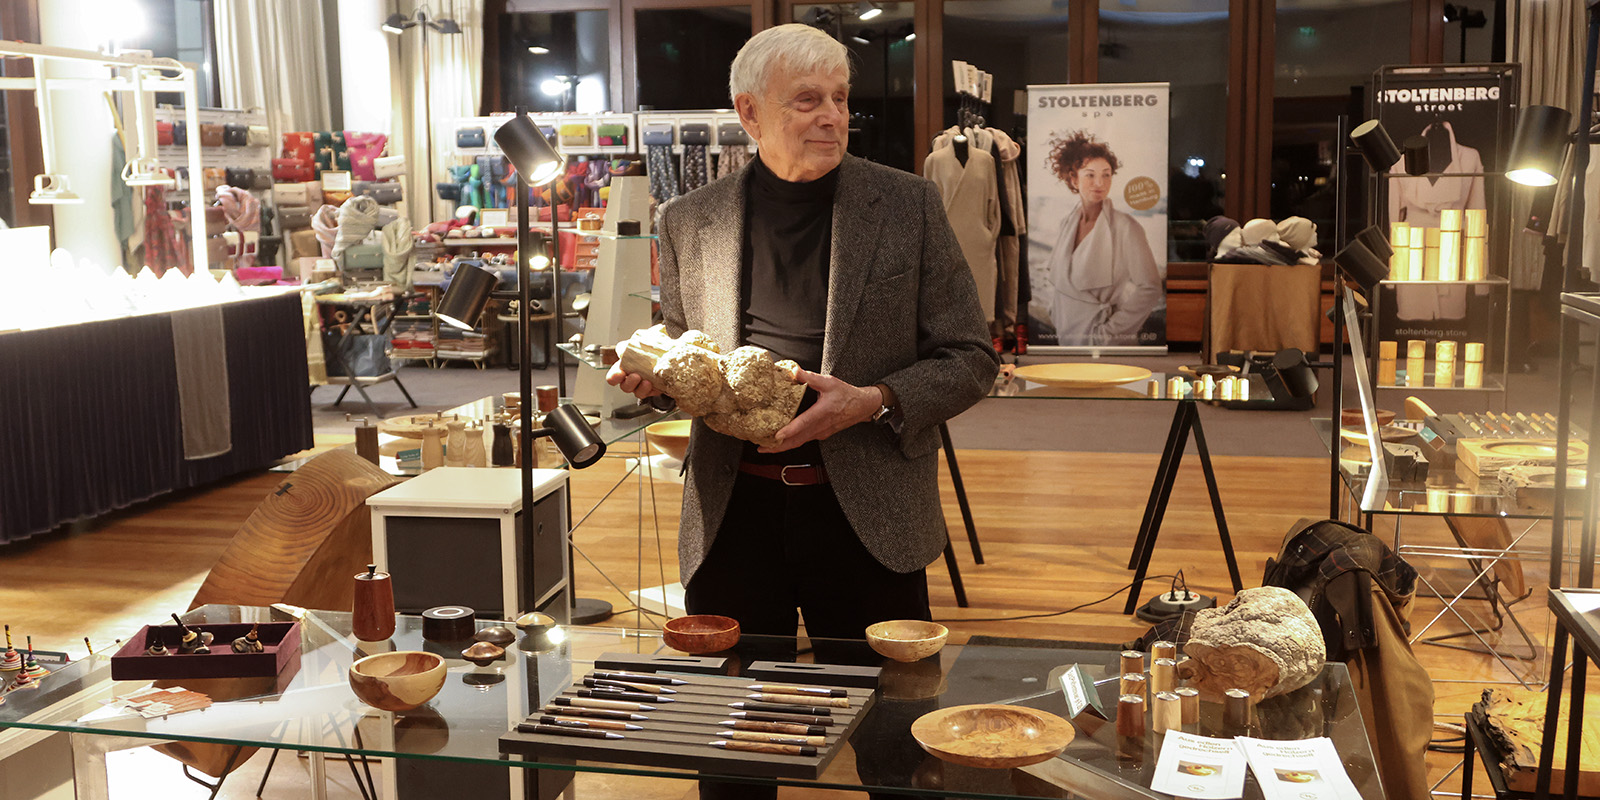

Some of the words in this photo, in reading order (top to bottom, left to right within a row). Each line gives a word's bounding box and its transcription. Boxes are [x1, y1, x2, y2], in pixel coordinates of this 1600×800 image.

[1377, 87, 1500, 103] STOLTENBERG
[1038, 94, 1158, 108] STOLTENBERG
[1414, 103, 1463, 113] street
[1129, 194, 1159, 205] Hamburg
[1395, 327, 1468, 338] stoltenberg.store
